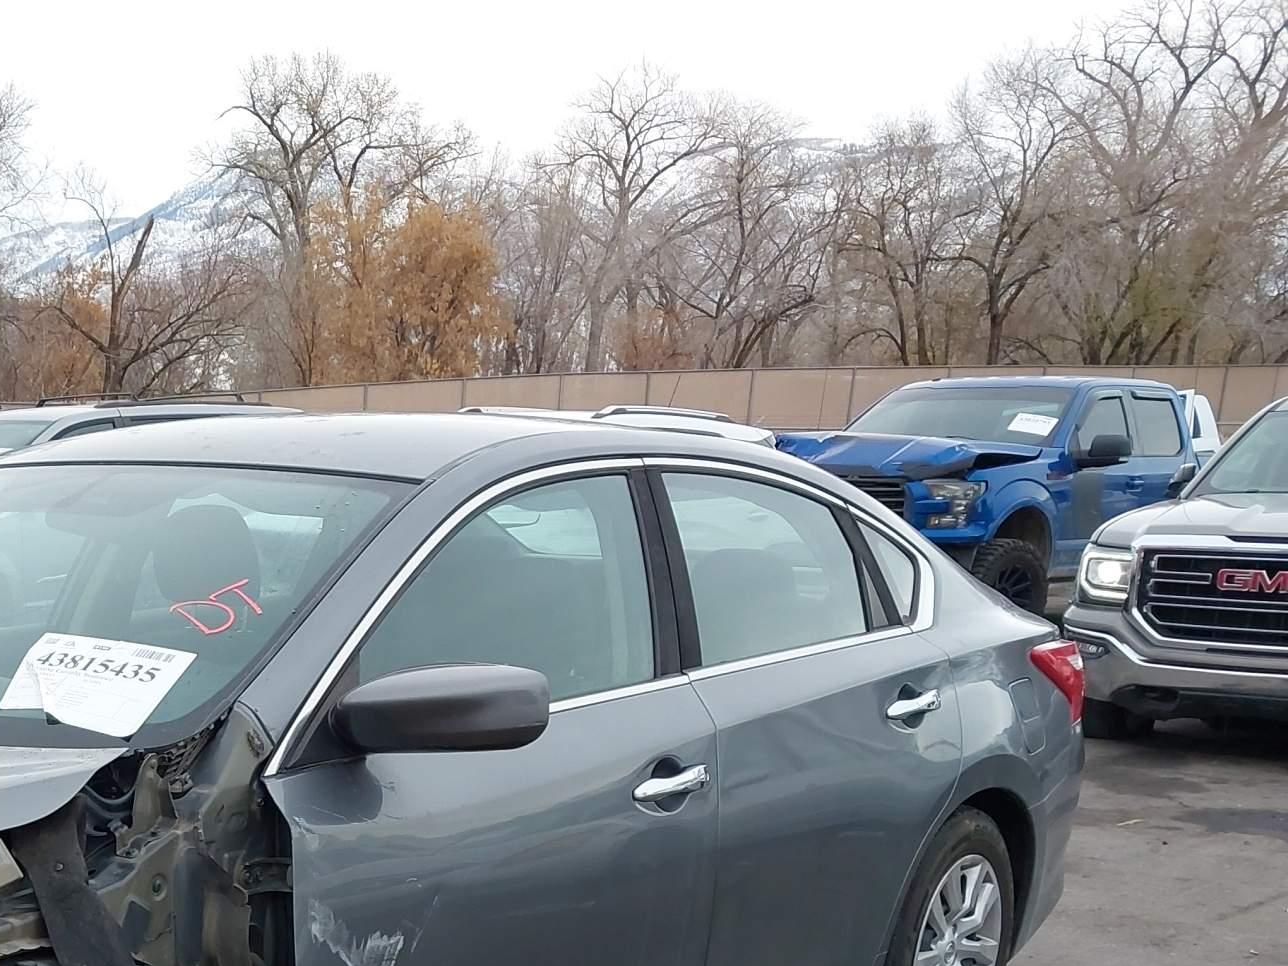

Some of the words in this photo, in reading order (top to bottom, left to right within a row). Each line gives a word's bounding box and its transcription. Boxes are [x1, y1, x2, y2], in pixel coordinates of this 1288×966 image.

[1216, 568, 1288, 594] GM
[169, 578, 263, 636] DT
[36, 650, 162, 683] 43815435
